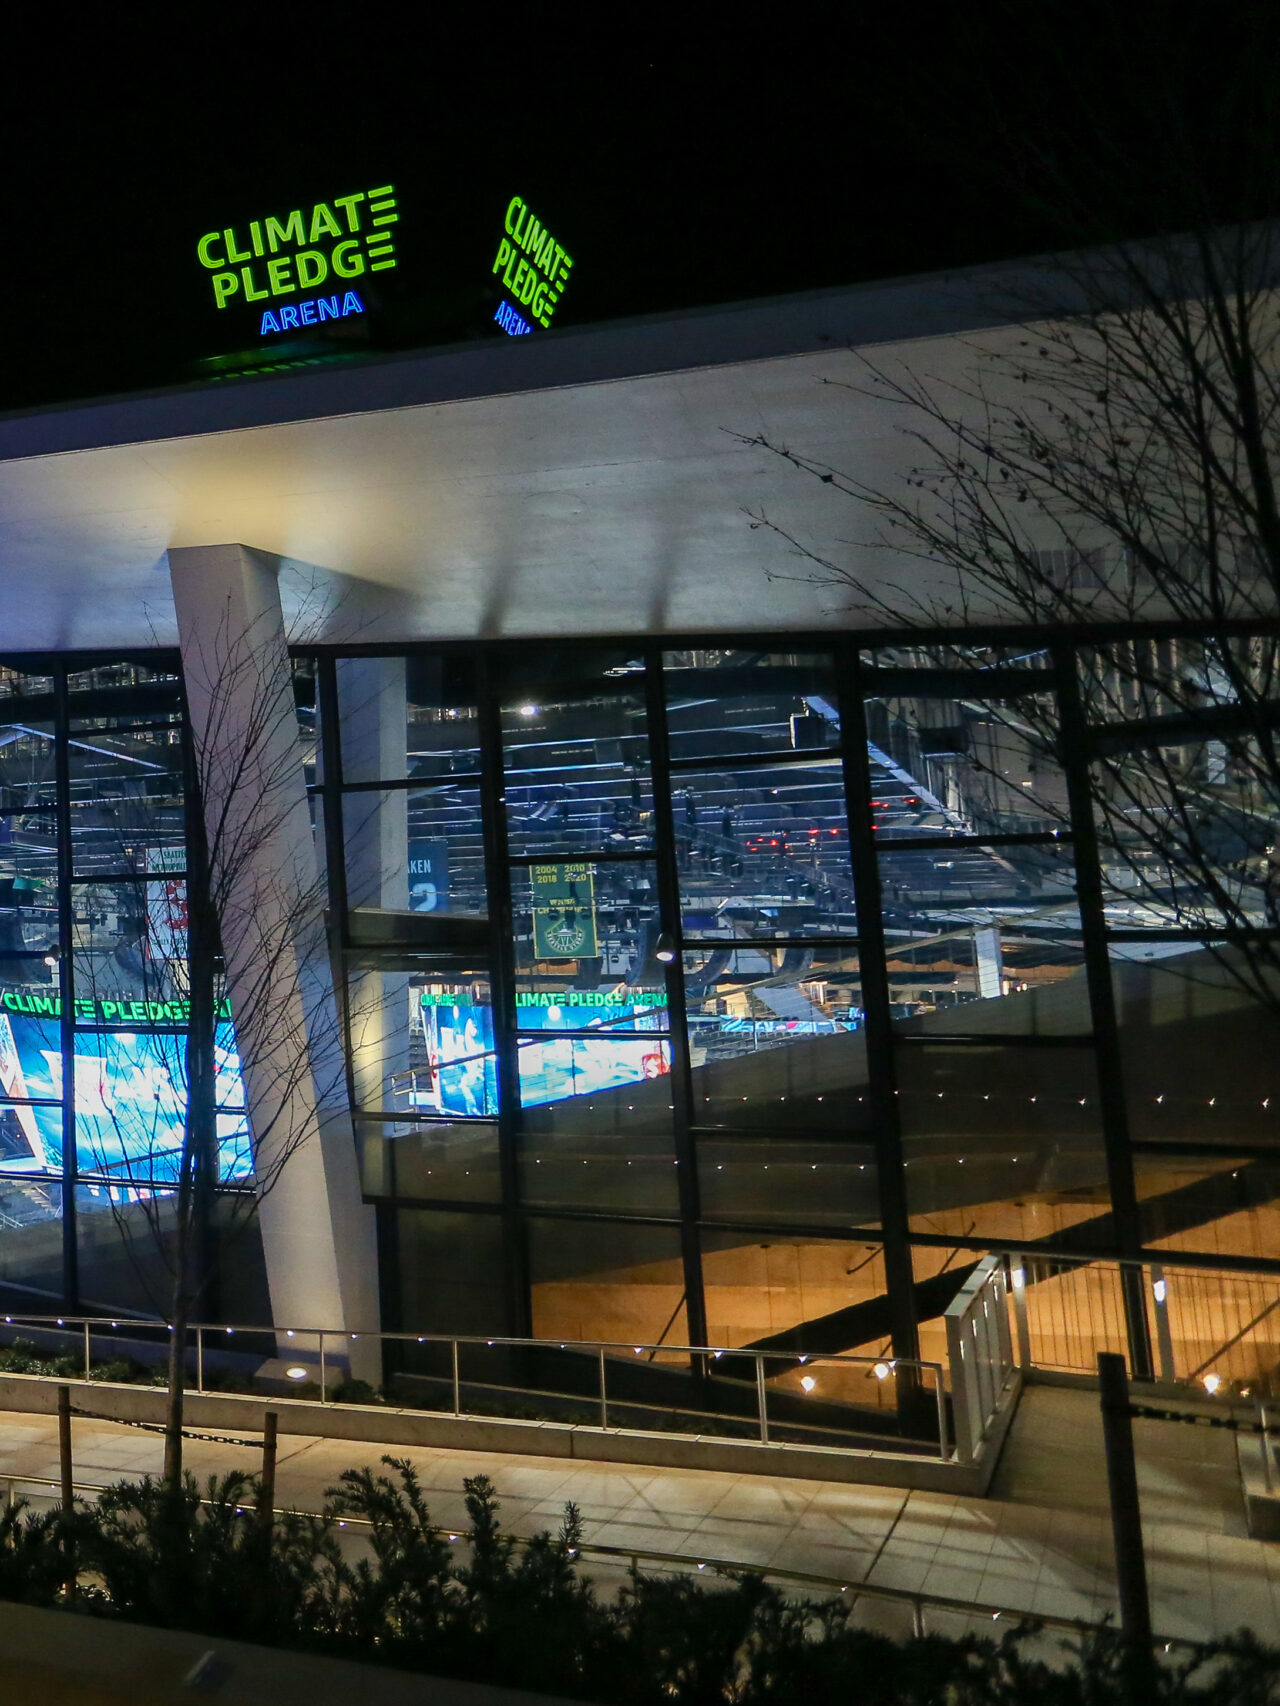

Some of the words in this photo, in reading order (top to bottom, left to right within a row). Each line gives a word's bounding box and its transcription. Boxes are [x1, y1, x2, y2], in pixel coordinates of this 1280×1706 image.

[197, 184, 399, 269] CLIMATE
[504, 196, 573, 293] CLIMATE
[211, 230, 397, 309] PLEDGE
[492, 237, 558, 329] PLEDGE
[260, 290, 365, 335] ARENA
[535, 866, 557, 874] 2004
[564, 864, 585, 872] 2010
[101, 1000, 192, 1021] PLEDGE
[569, 992, 623, 1007] PLEDGE
